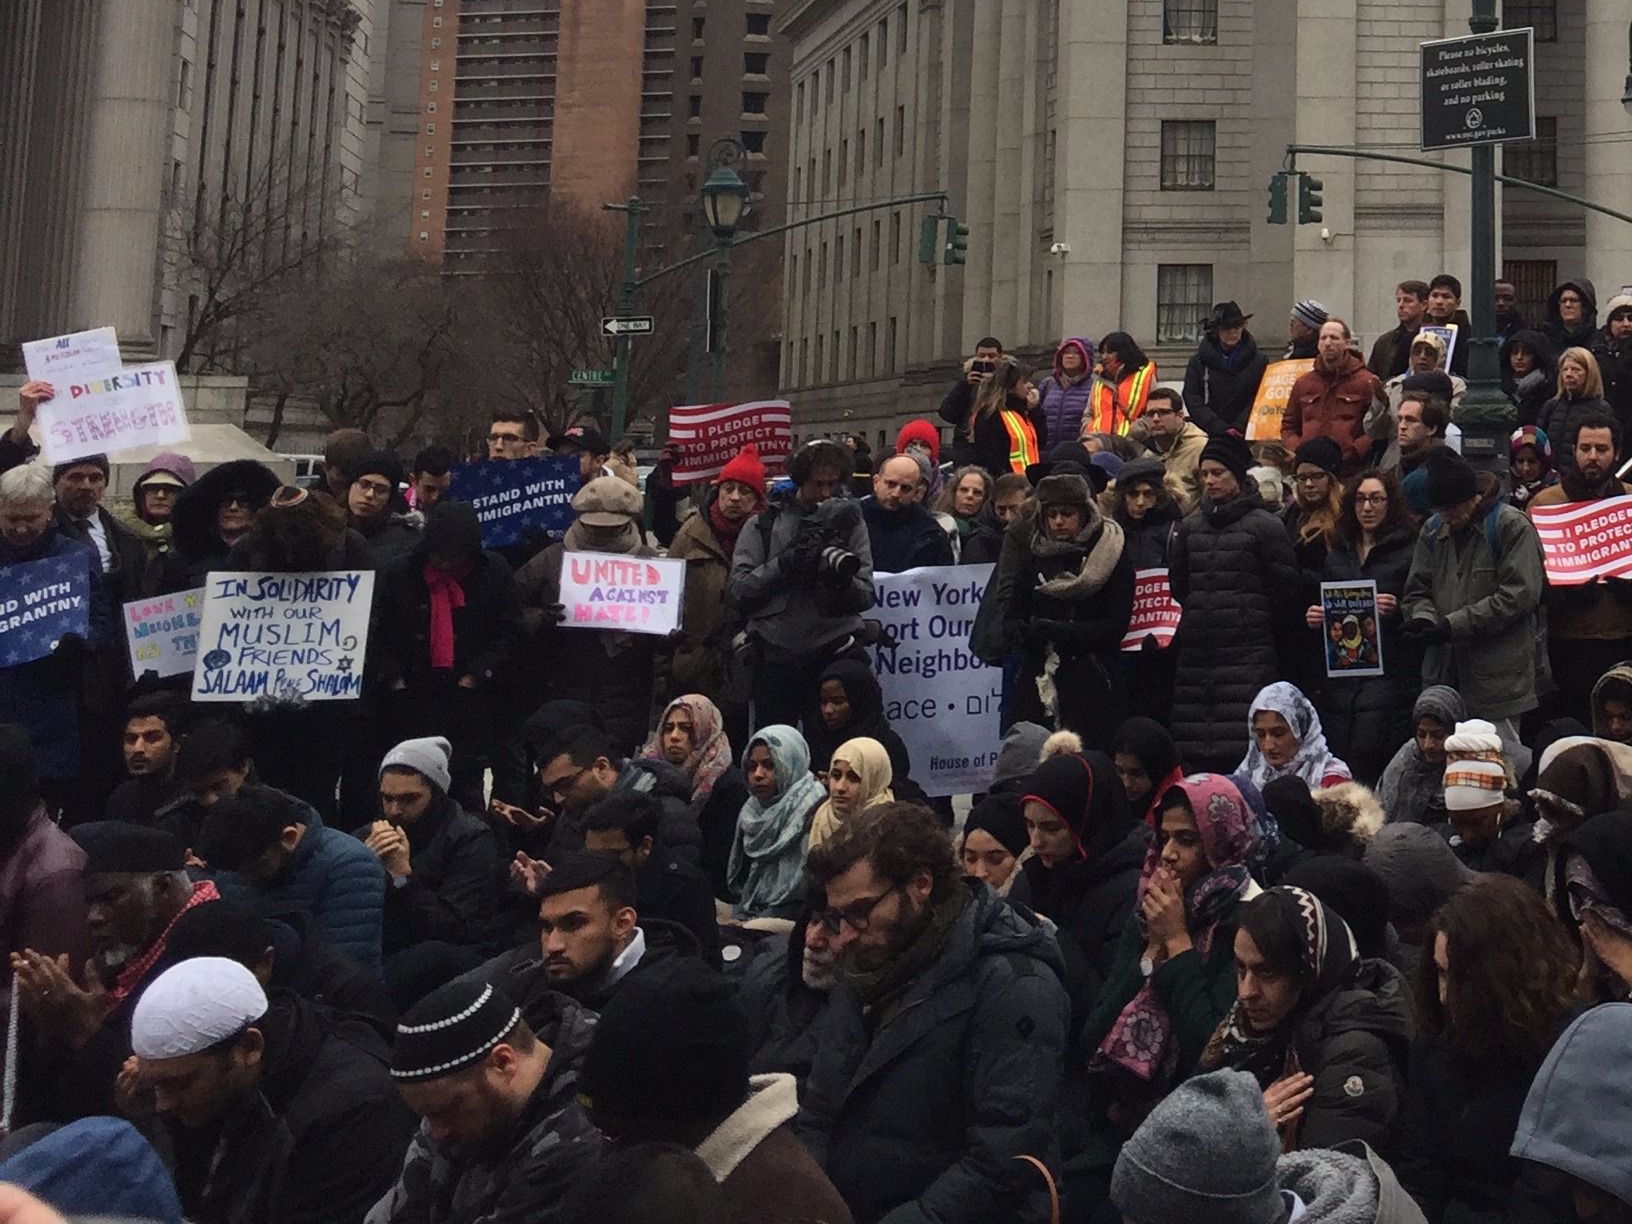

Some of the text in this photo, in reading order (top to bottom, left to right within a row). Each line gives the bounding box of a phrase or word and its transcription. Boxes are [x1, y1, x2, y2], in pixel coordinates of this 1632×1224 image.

[1443, 91, 1505, 105] and no parking
[633, 321, 647, 329] WAY
[70, 370, 166, 399] DIVERSITY
[571, 370, 602, 382] CENTRE
[51, 401, 176, 444] STRENGTH
[698, 415, 760, 438] I PLEDGE
[688, 428, 772, 453] TO PROTECT
[472, 479, 565, 509] STAND WITH
[1565, 510, 1627, 538] I PLEDGE
[1557, 542, 1576, 554] TO
[571, 558, 661, 586] UNITED
[24, 581, 71, 606] WITH
[213, 573, 361, 604] IN SOLIDARITY
[589, 587, 669, 604] AGAINST
[230, 606, 322, 620] WITH OUR
[218, 618, 340, 649] MUSLIM
[928, 614, 974, 639] Our
[238, 646, 333, 666] FRIENDS
[877, 648, 988, 678] Neighbo
[198, 669, 270, 695] SALAAM
[301, 669, 362, 696] SHALOM
[887, 698, 936, 721] ace
[930, 754, 969, 771] House
[973, 752, 985, 768] of
